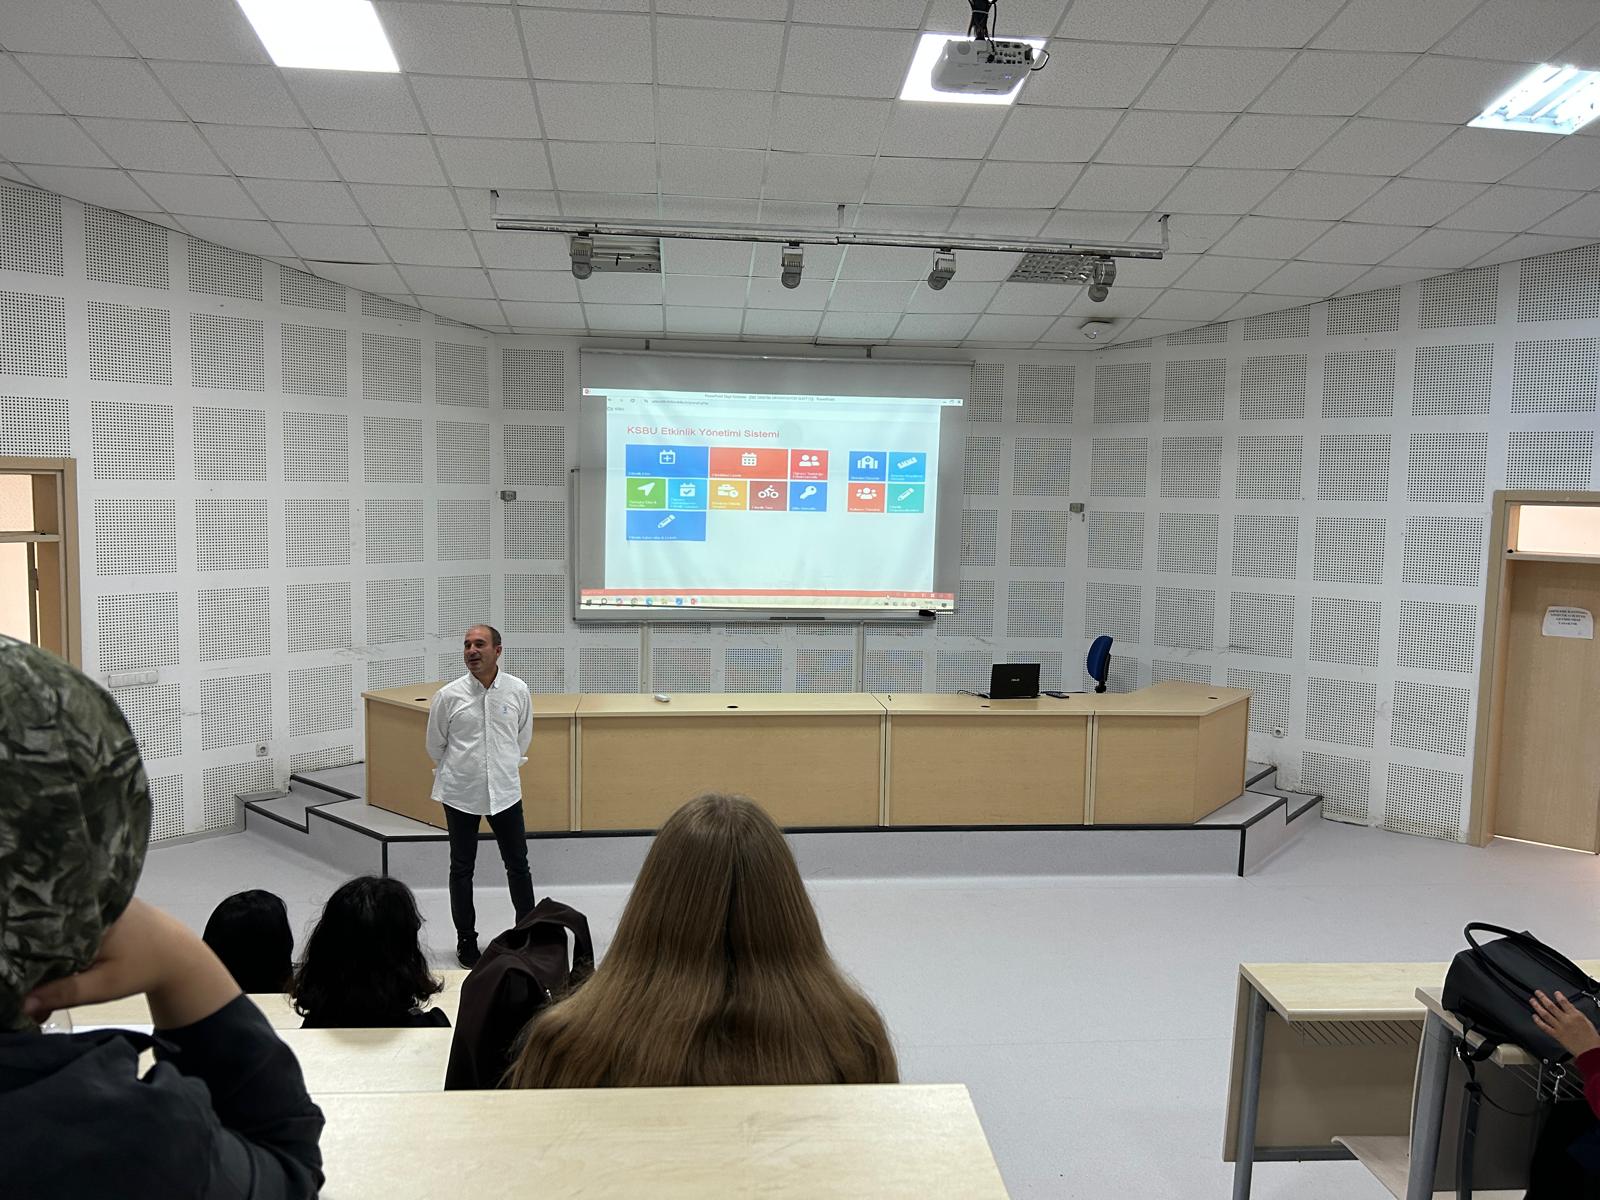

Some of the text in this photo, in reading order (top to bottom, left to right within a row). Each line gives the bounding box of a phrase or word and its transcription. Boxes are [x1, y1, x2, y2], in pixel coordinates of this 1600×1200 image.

[661, 427, 697, 437] Etkinlik
[699, 428, 742, 438] Yönetimi
[743, 430, 780, 439] Sistemi
